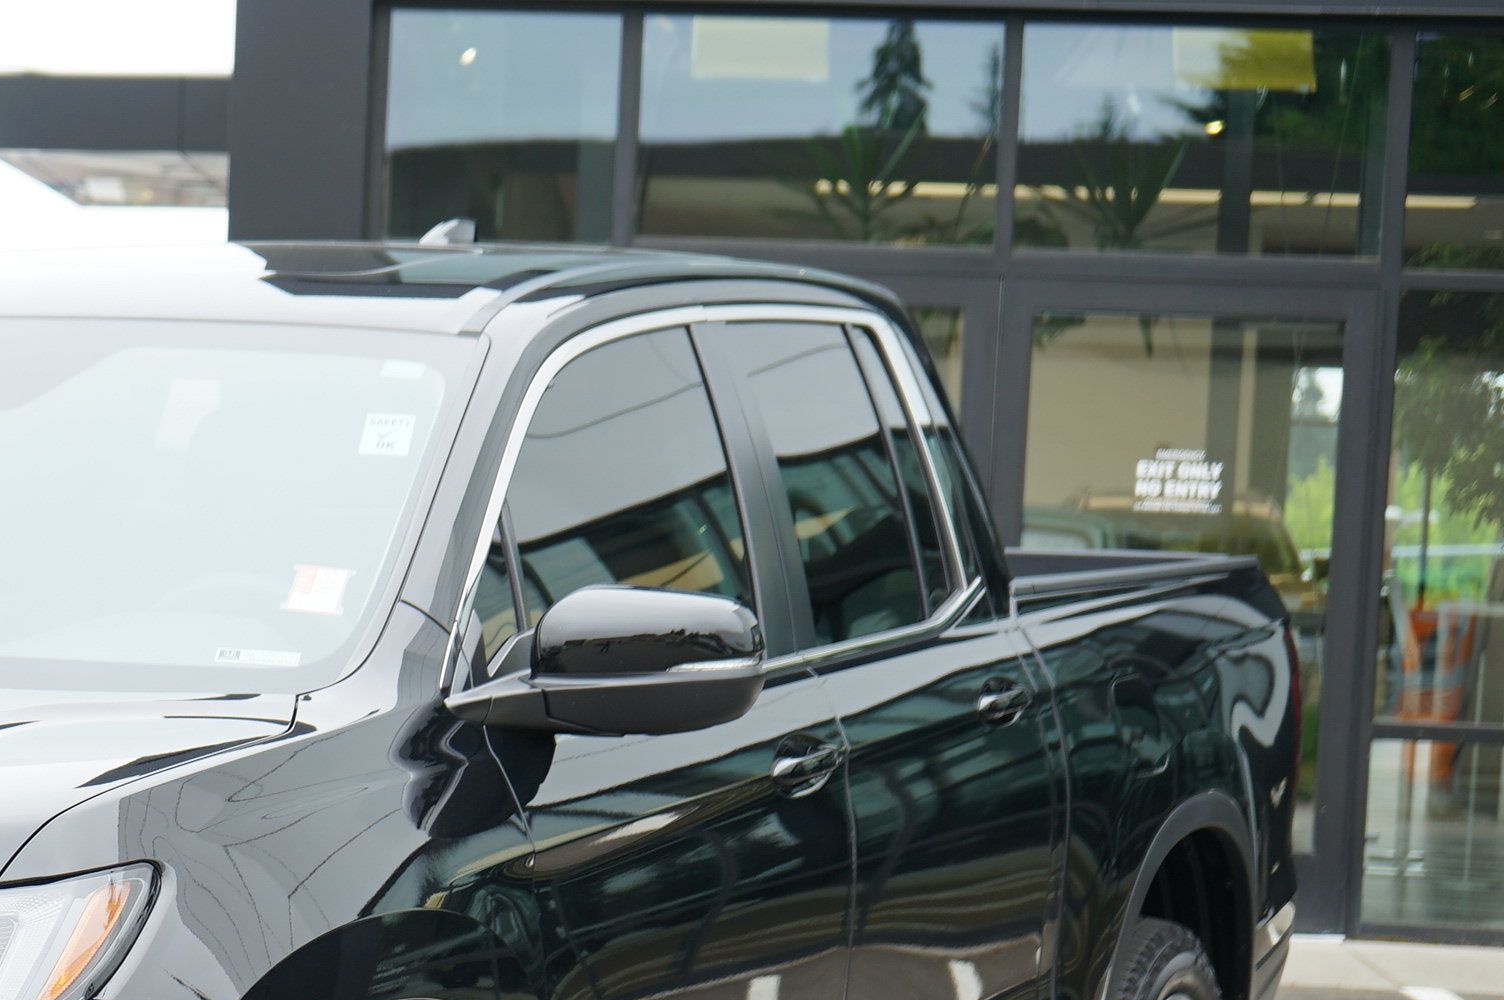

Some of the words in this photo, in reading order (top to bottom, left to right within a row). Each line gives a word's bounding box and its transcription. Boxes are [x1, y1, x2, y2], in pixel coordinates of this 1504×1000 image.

[1136, 459, 1175, 479] EXIT
[1134, 479, 1162, 498] NO
[1164, 479, 1223, 500] ENTRY
